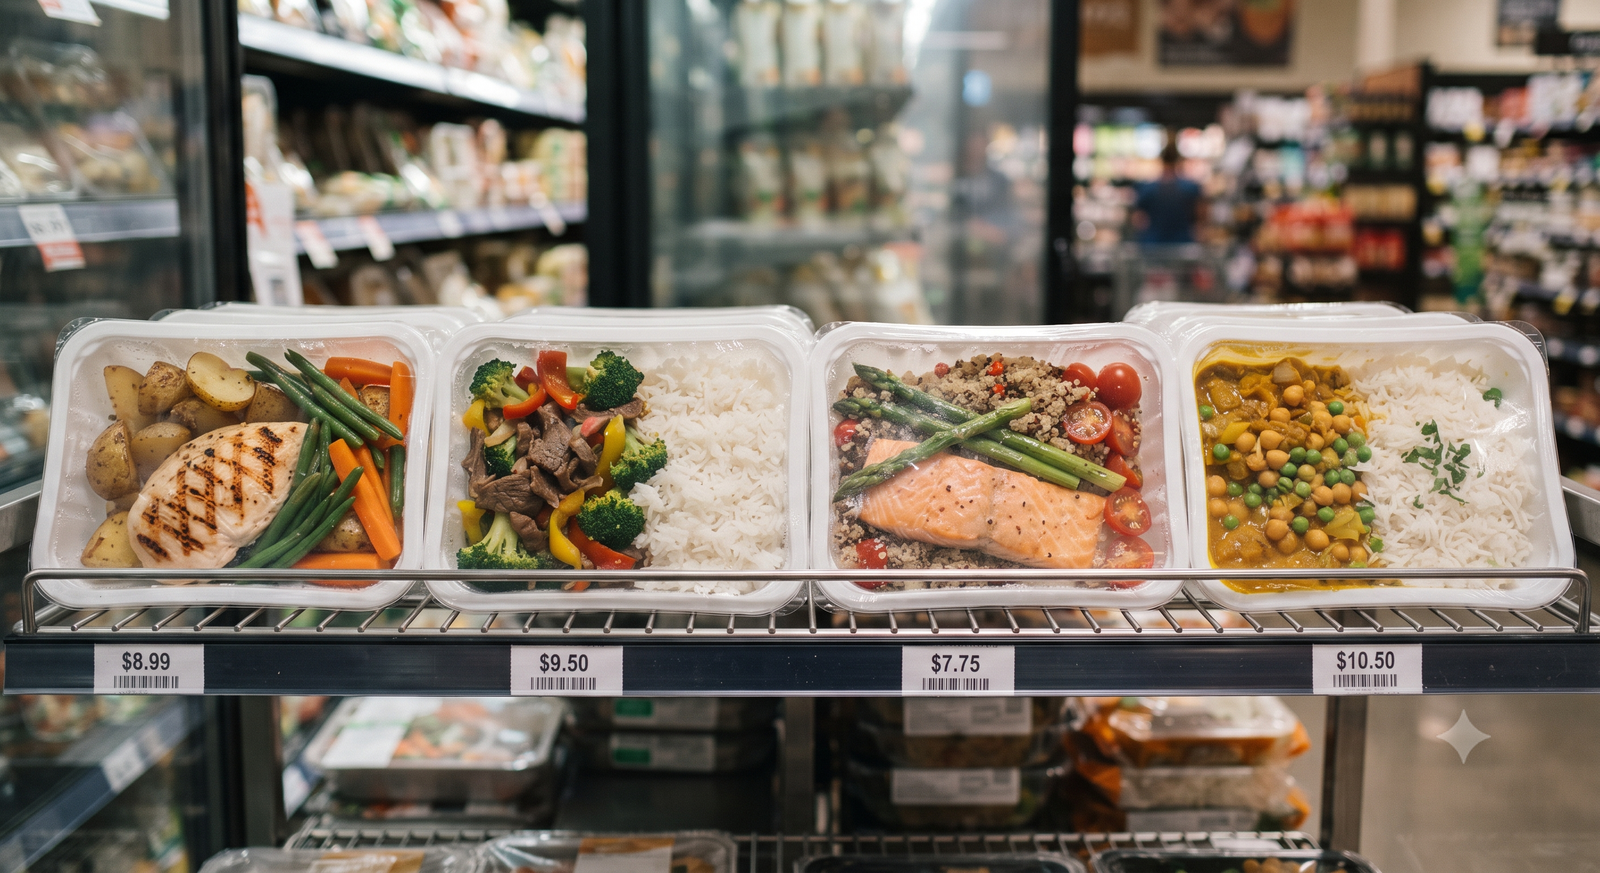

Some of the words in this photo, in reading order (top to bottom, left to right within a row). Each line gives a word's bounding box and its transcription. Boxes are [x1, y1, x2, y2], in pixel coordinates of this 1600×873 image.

[122, 651, 171, 673] $8.99
[539, 653, 589, 674] $9.50
[931, 653, 980, 674] $7.75
[1336, 650, 1395, 672] $10.50
